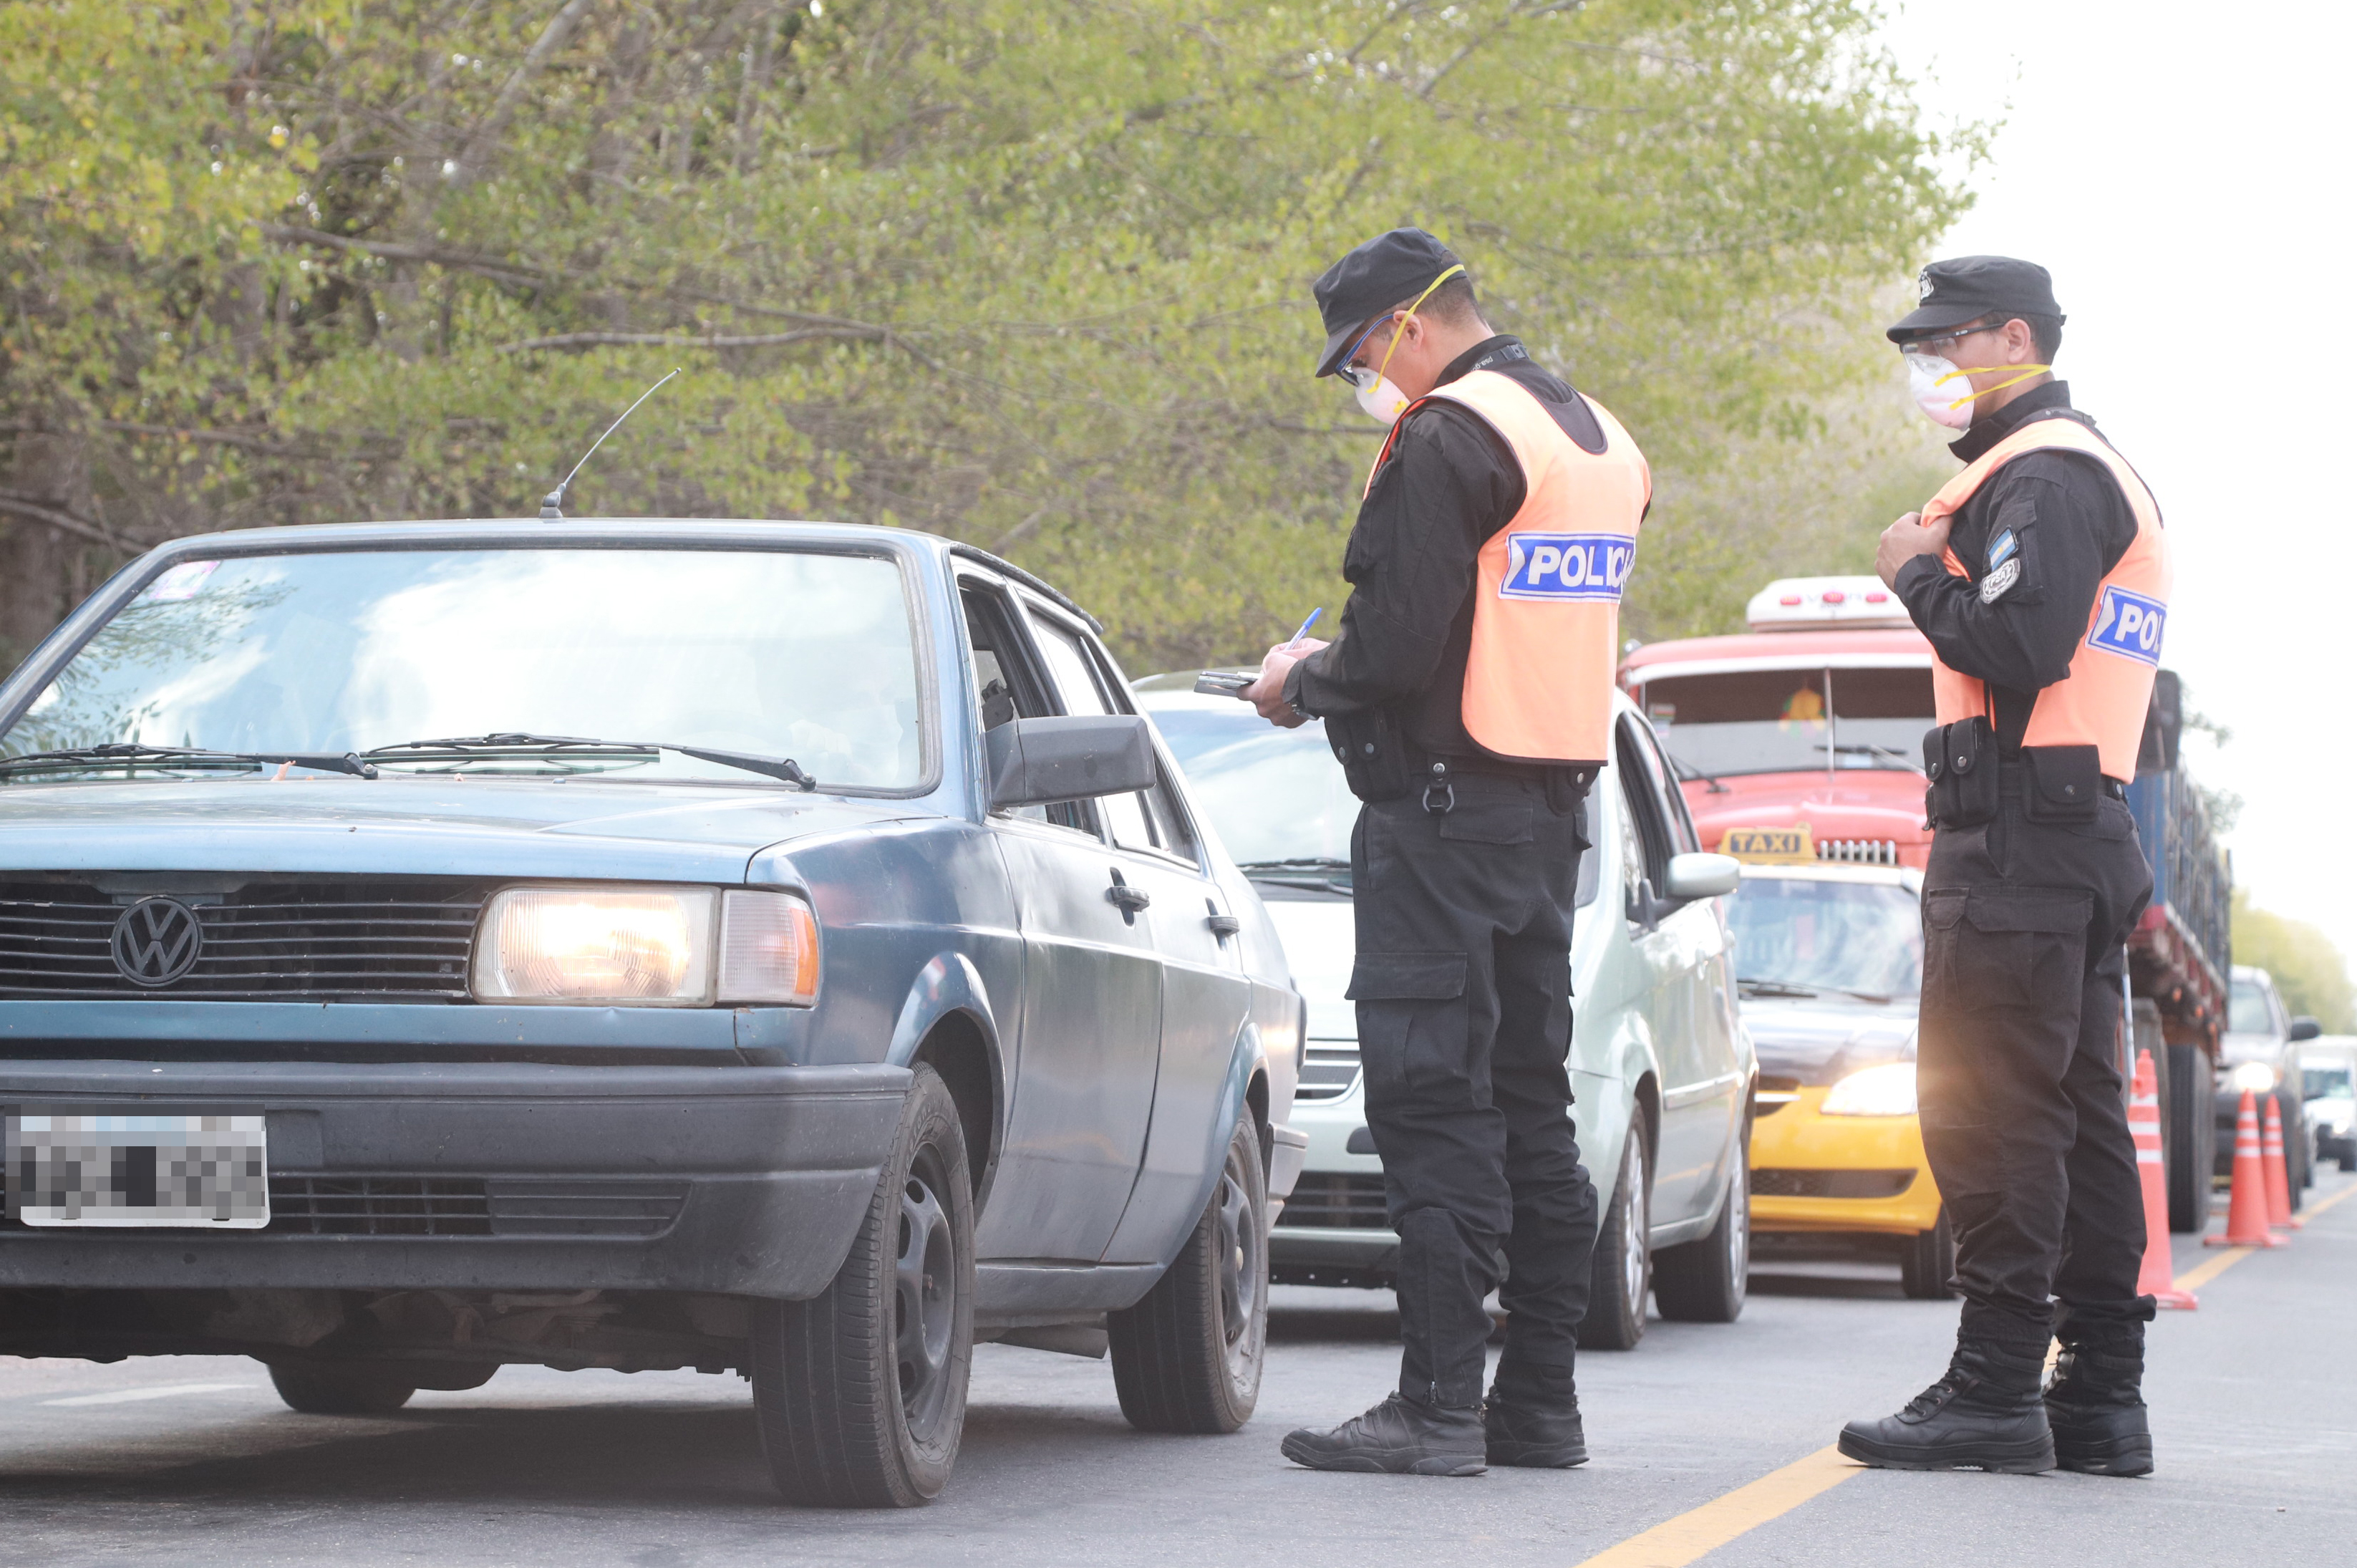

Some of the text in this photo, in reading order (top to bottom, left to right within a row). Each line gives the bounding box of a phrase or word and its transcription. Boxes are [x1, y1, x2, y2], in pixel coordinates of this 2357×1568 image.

[1470, 356, 1494, 372] psa.go
[1990, 569, 2007, 587] PSA
[1735, 833, 1796, 851] TAXI
